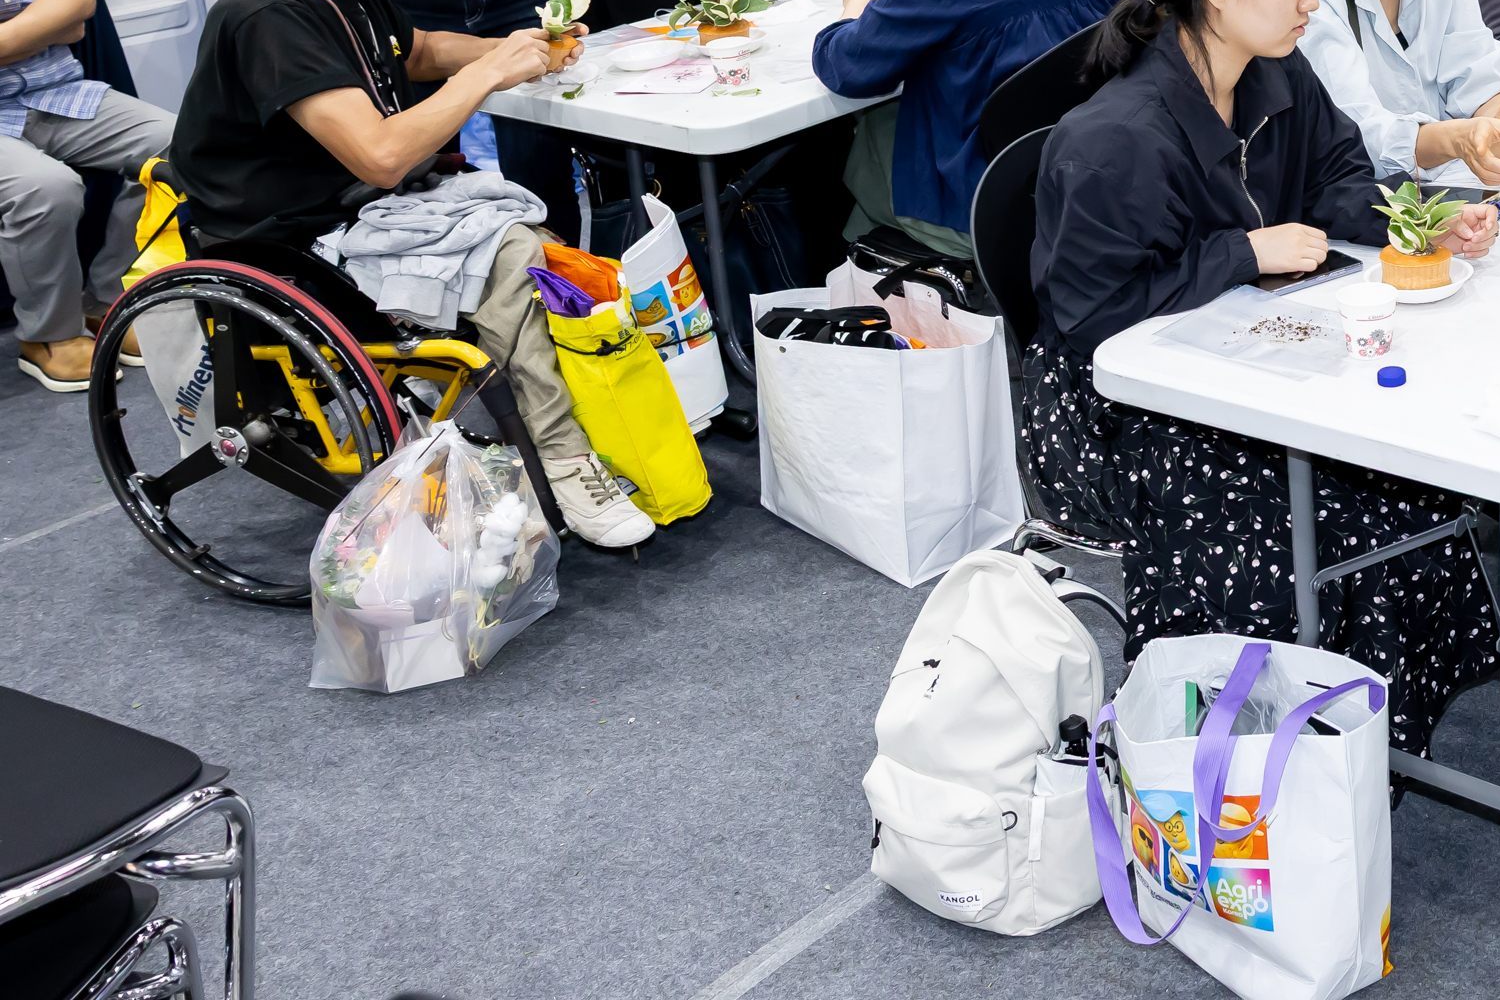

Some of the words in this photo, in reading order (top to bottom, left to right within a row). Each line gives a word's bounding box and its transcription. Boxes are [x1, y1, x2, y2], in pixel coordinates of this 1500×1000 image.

[940, 894, 981, 904] KANGOL
[1215, 877, 1263, 904] Agri
[1217, 895, 1269, 920] expo
[1222, 907, 1244, 918] Korea
